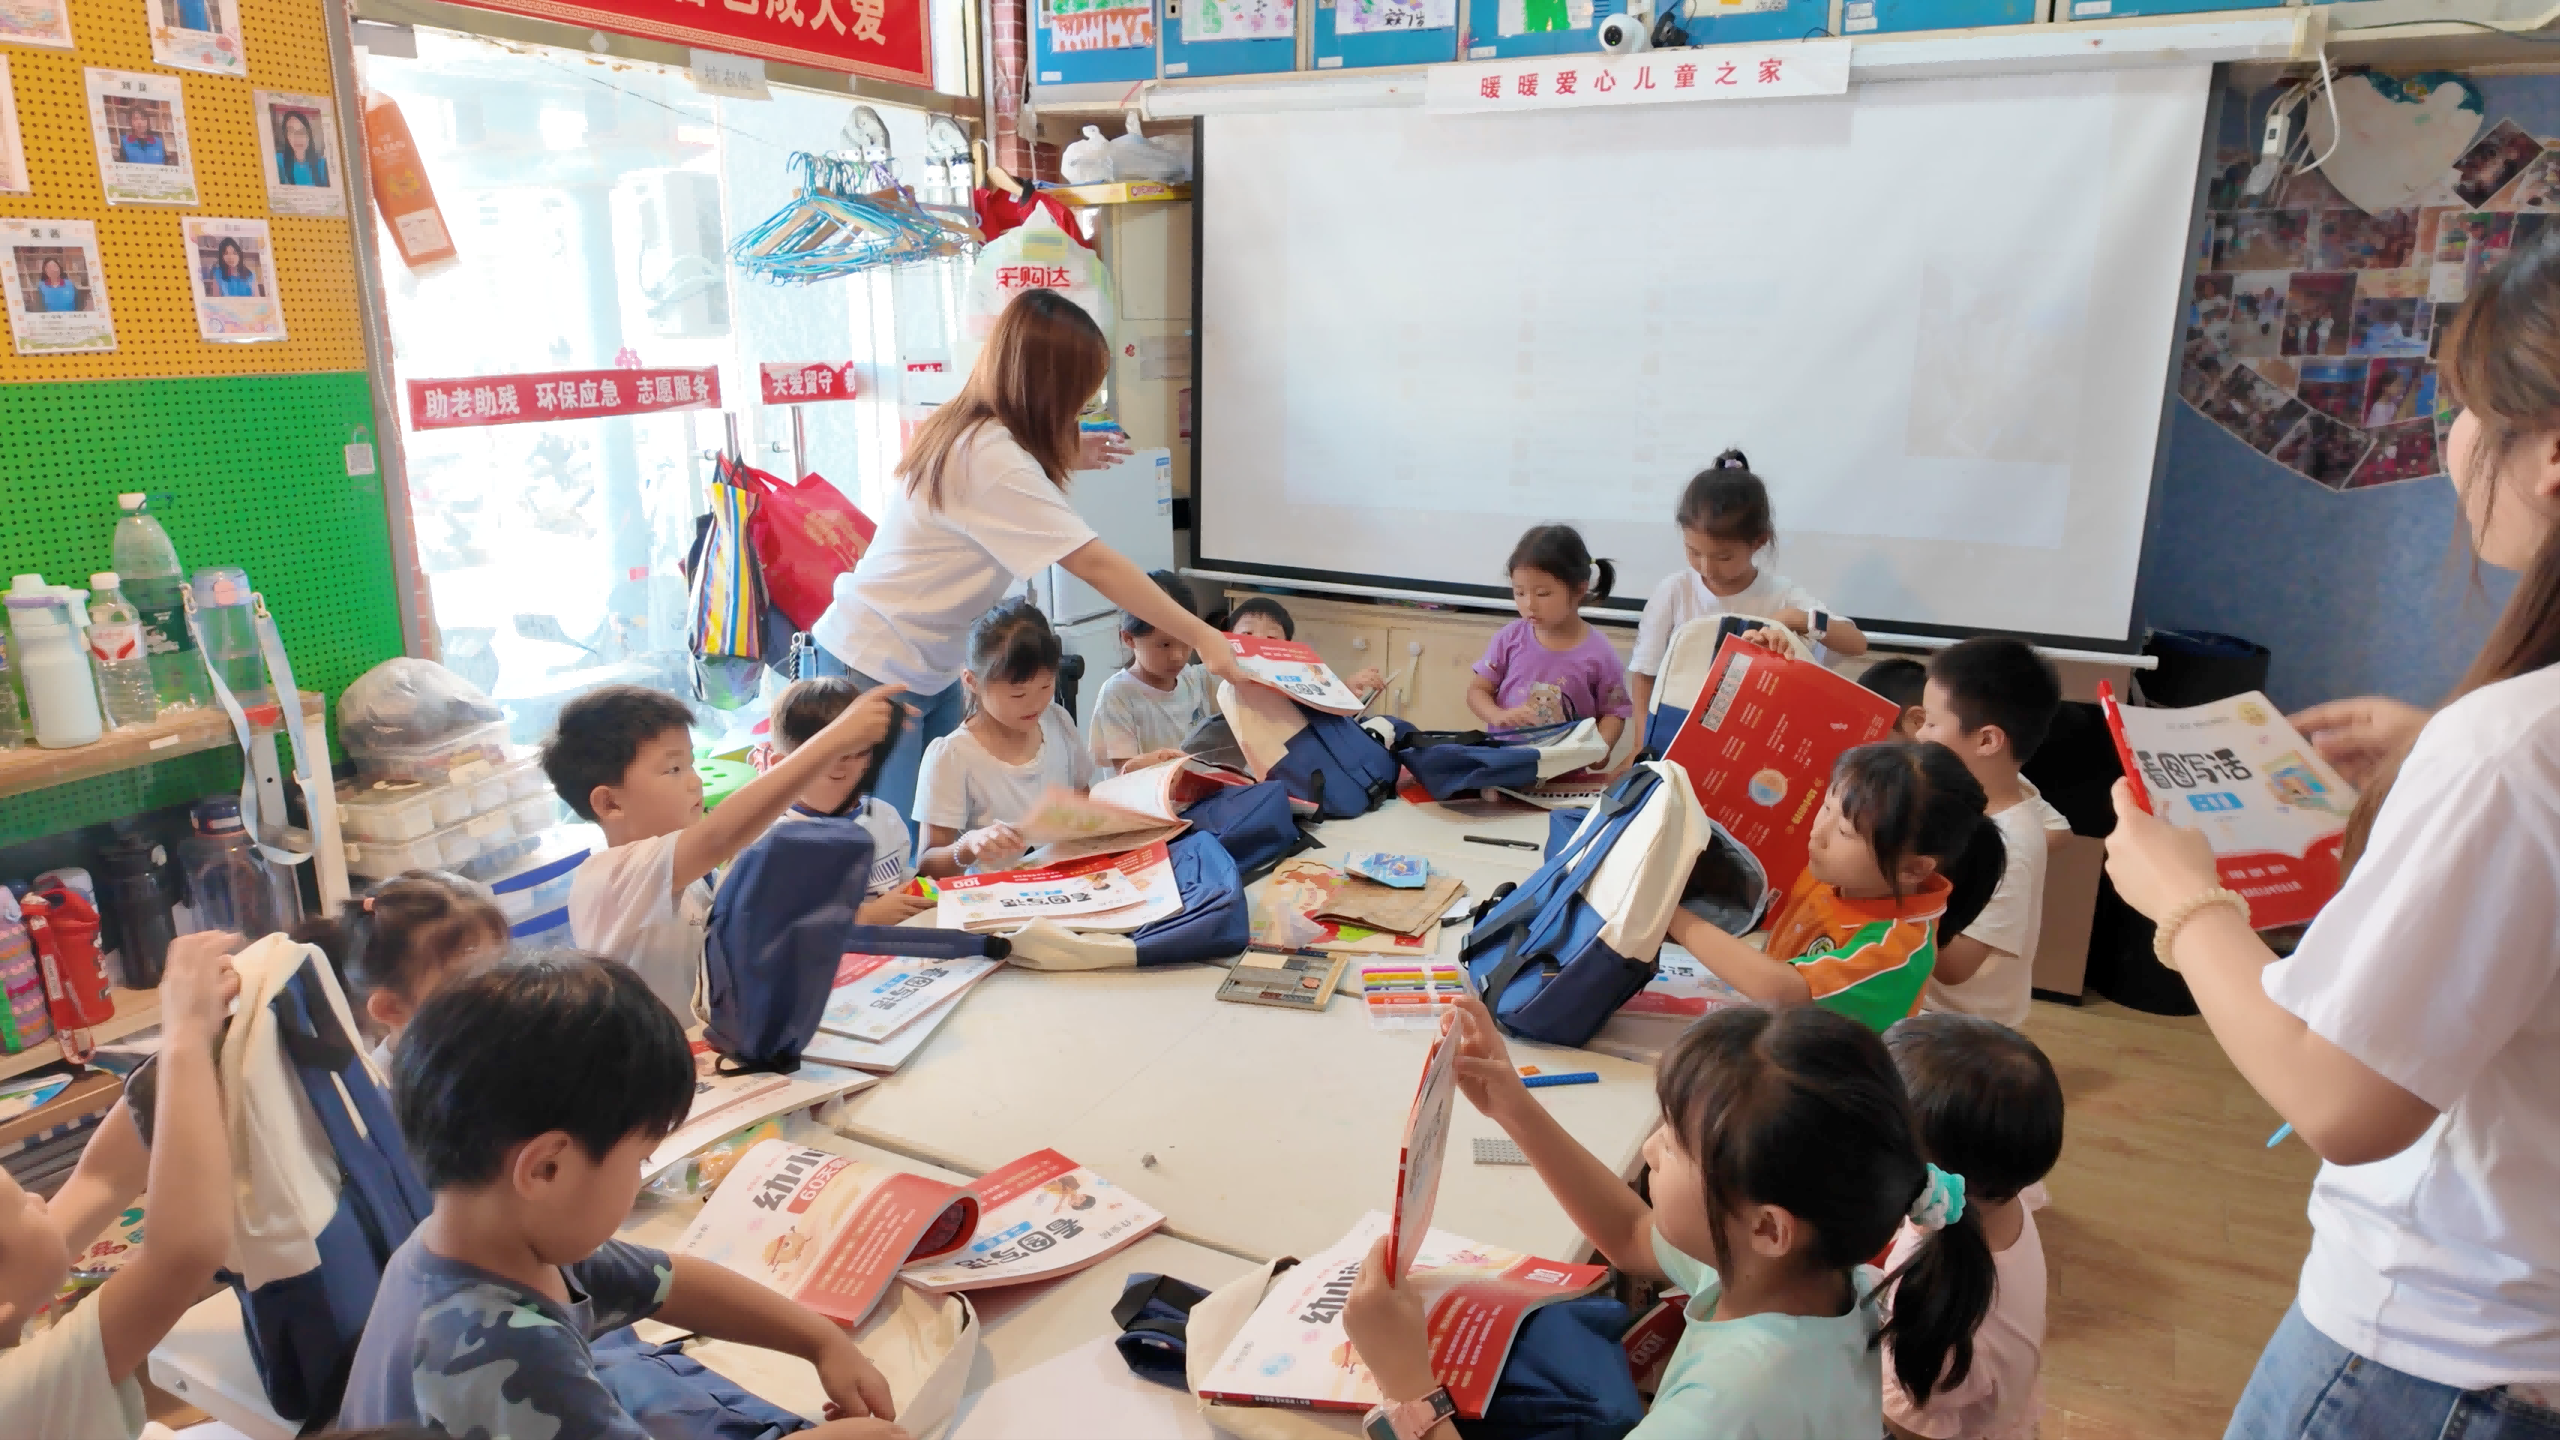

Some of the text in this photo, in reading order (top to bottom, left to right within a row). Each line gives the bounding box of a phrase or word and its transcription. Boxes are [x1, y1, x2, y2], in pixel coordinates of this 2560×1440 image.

[1480, 57, 1784, 99] 暖暖爱心儿童之家
[424, 374, 712, 419] 助老助残 环保应急 志愿服务
[2135, 747, 2253, 790] 看图写话
[752, 1147, 837, 1212] 幼小
[954, 1217, 1085, 1270] 看图写话
